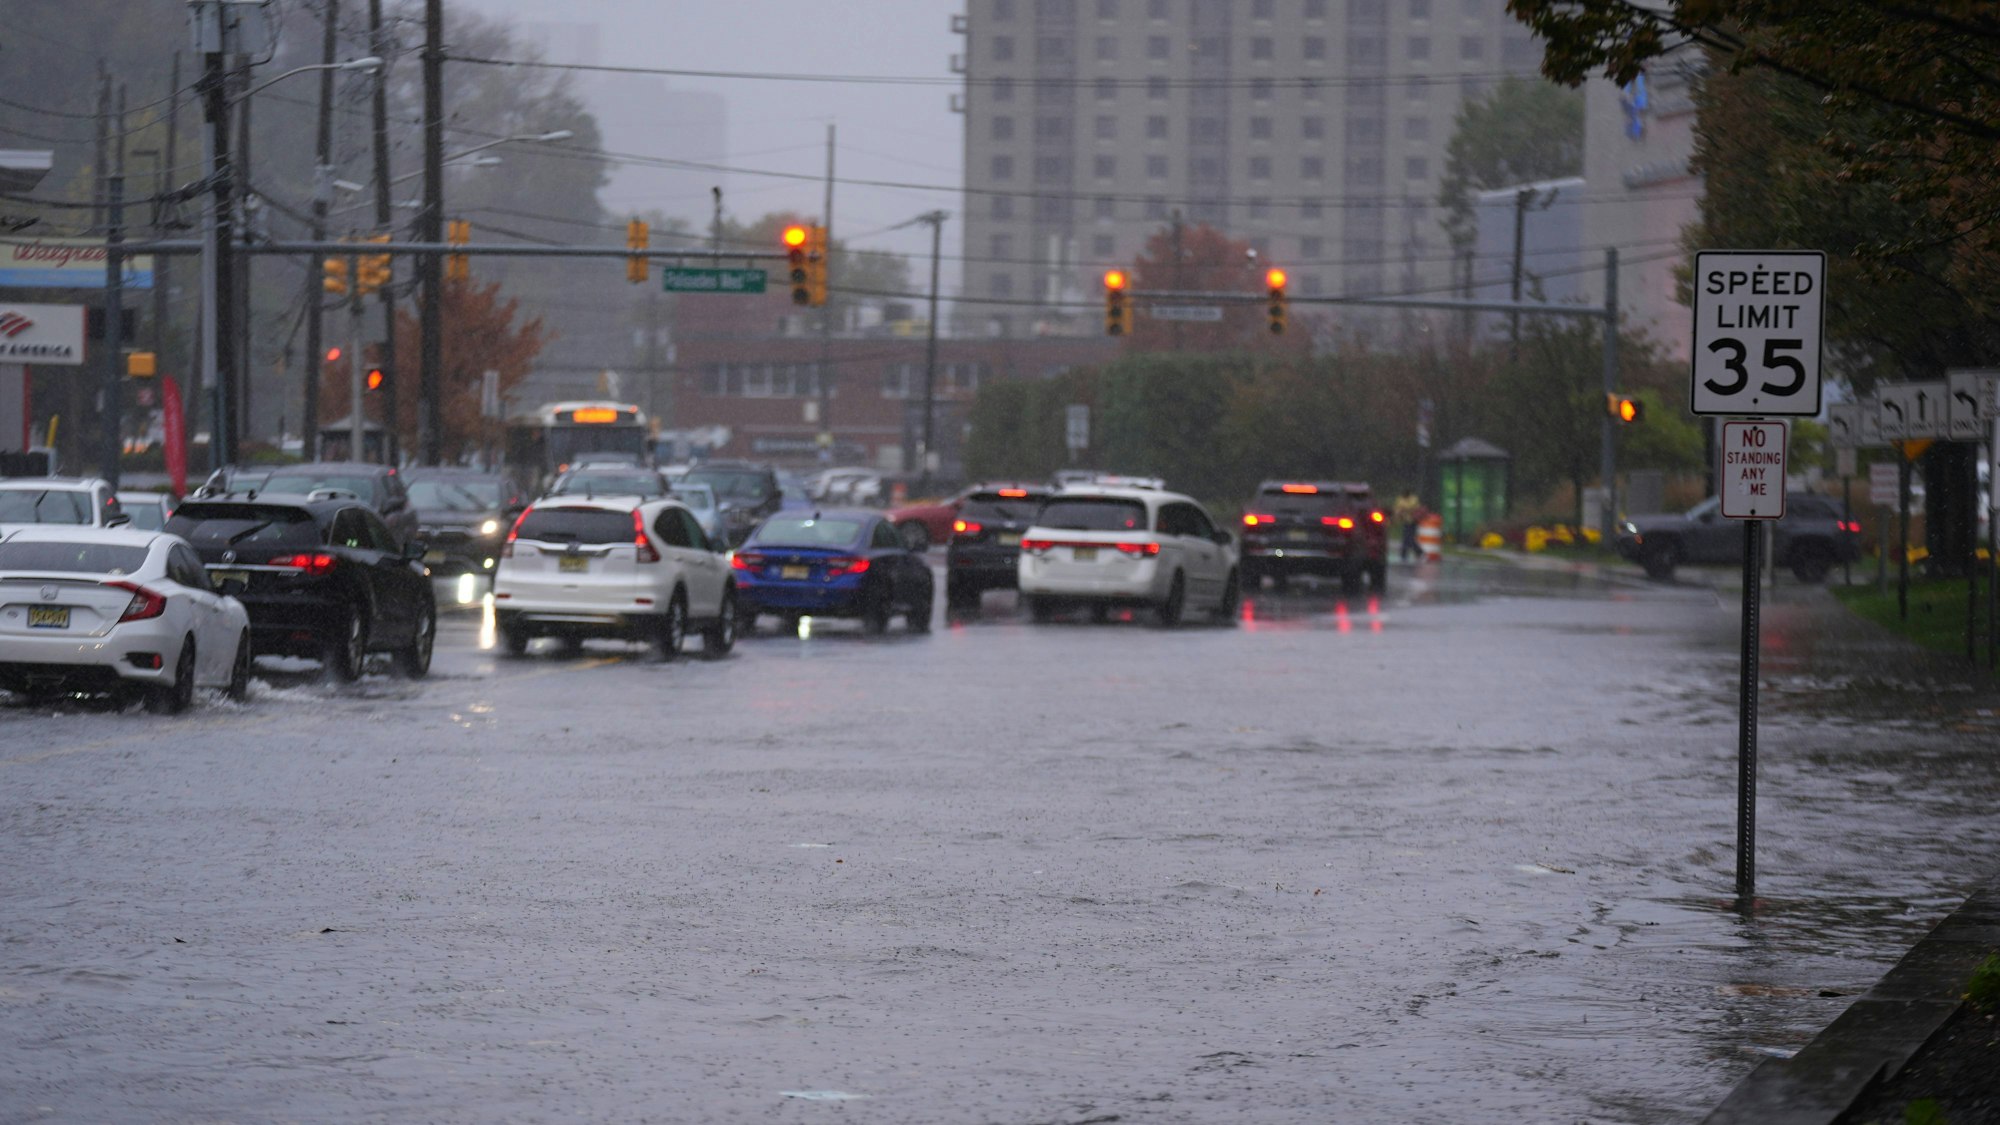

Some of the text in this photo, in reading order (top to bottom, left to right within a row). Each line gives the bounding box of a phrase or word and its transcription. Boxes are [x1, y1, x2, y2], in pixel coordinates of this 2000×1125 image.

[1706, 271, 1814, 295] SPEED
[1717, 305, 1800, 329] LIMIT
[9, 344, 72, 358] AMERICA
[1703, 337, 1806, 397] 35
[1742, 430, 1766, 448] NO
[1727, 452, 1781, 465] STANDING
[1741, 468, 1766, 480] ANY
